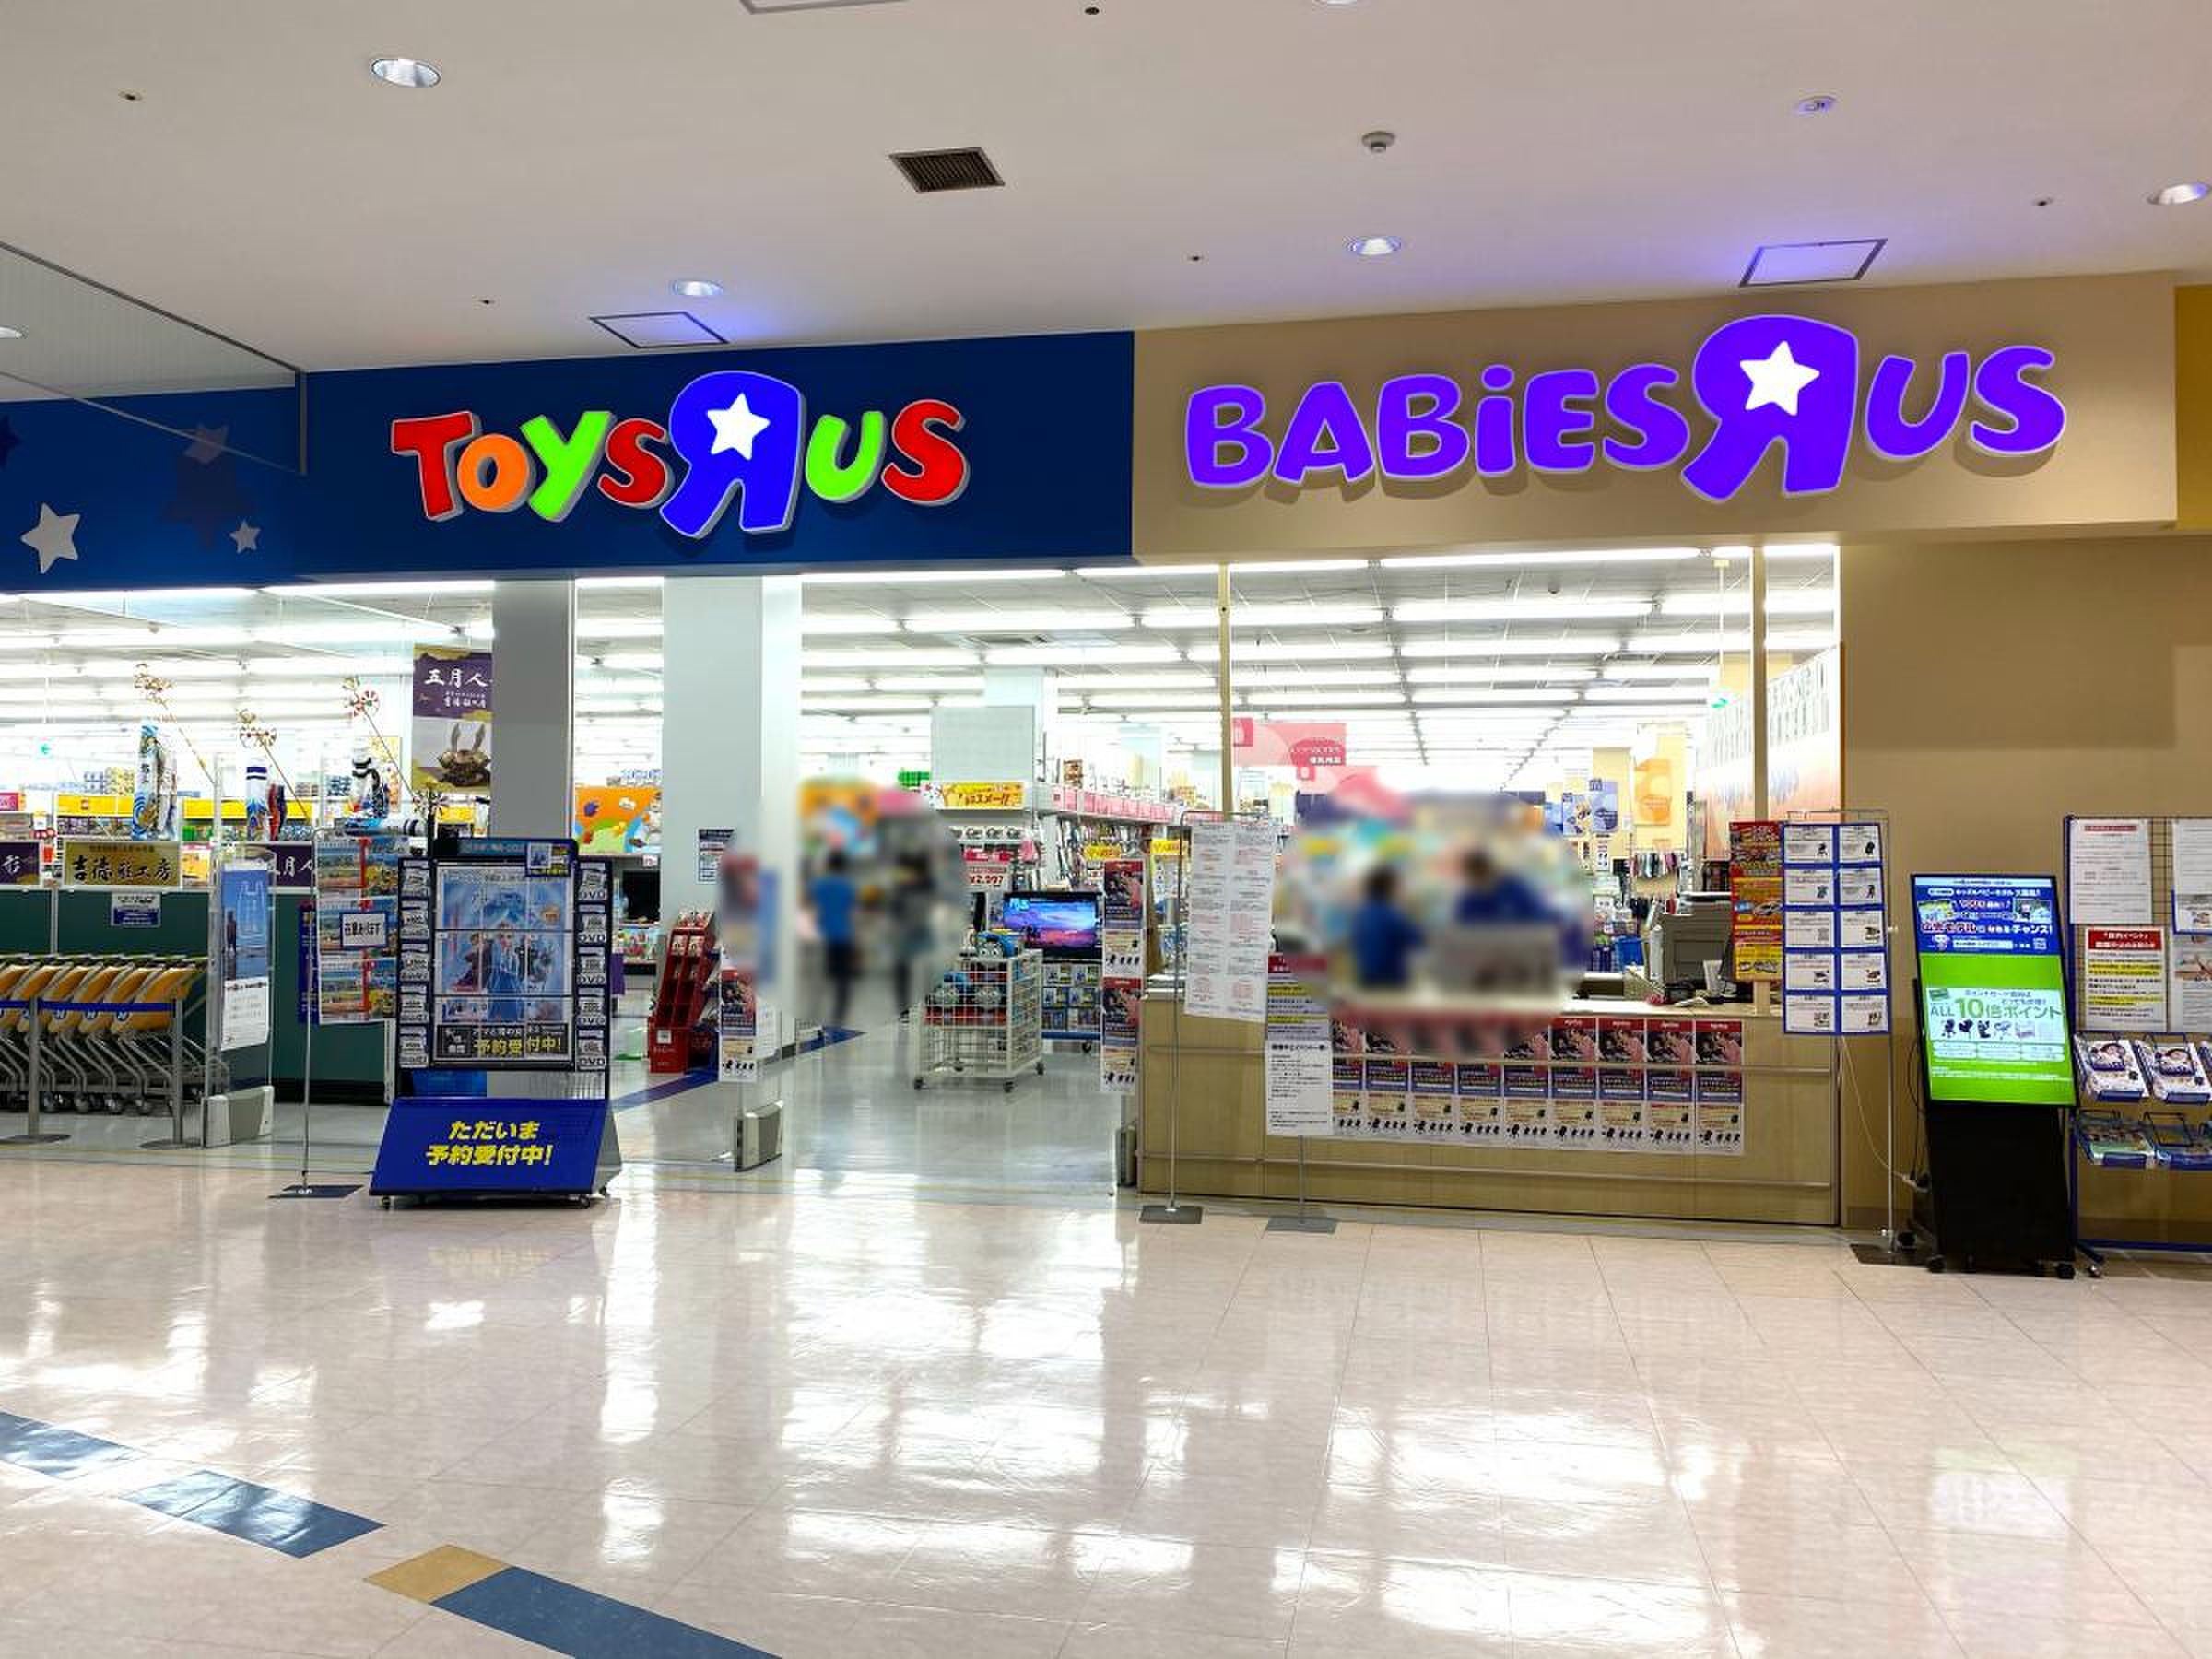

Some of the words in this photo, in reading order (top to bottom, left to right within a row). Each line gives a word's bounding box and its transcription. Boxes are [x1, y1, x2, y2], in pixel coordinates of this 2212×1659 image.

[424, 668, 494, 688] 五月人
[449, 1121, 540, 1140] ただいま
[426, 1144, 553, 1166] 予約受付中!
